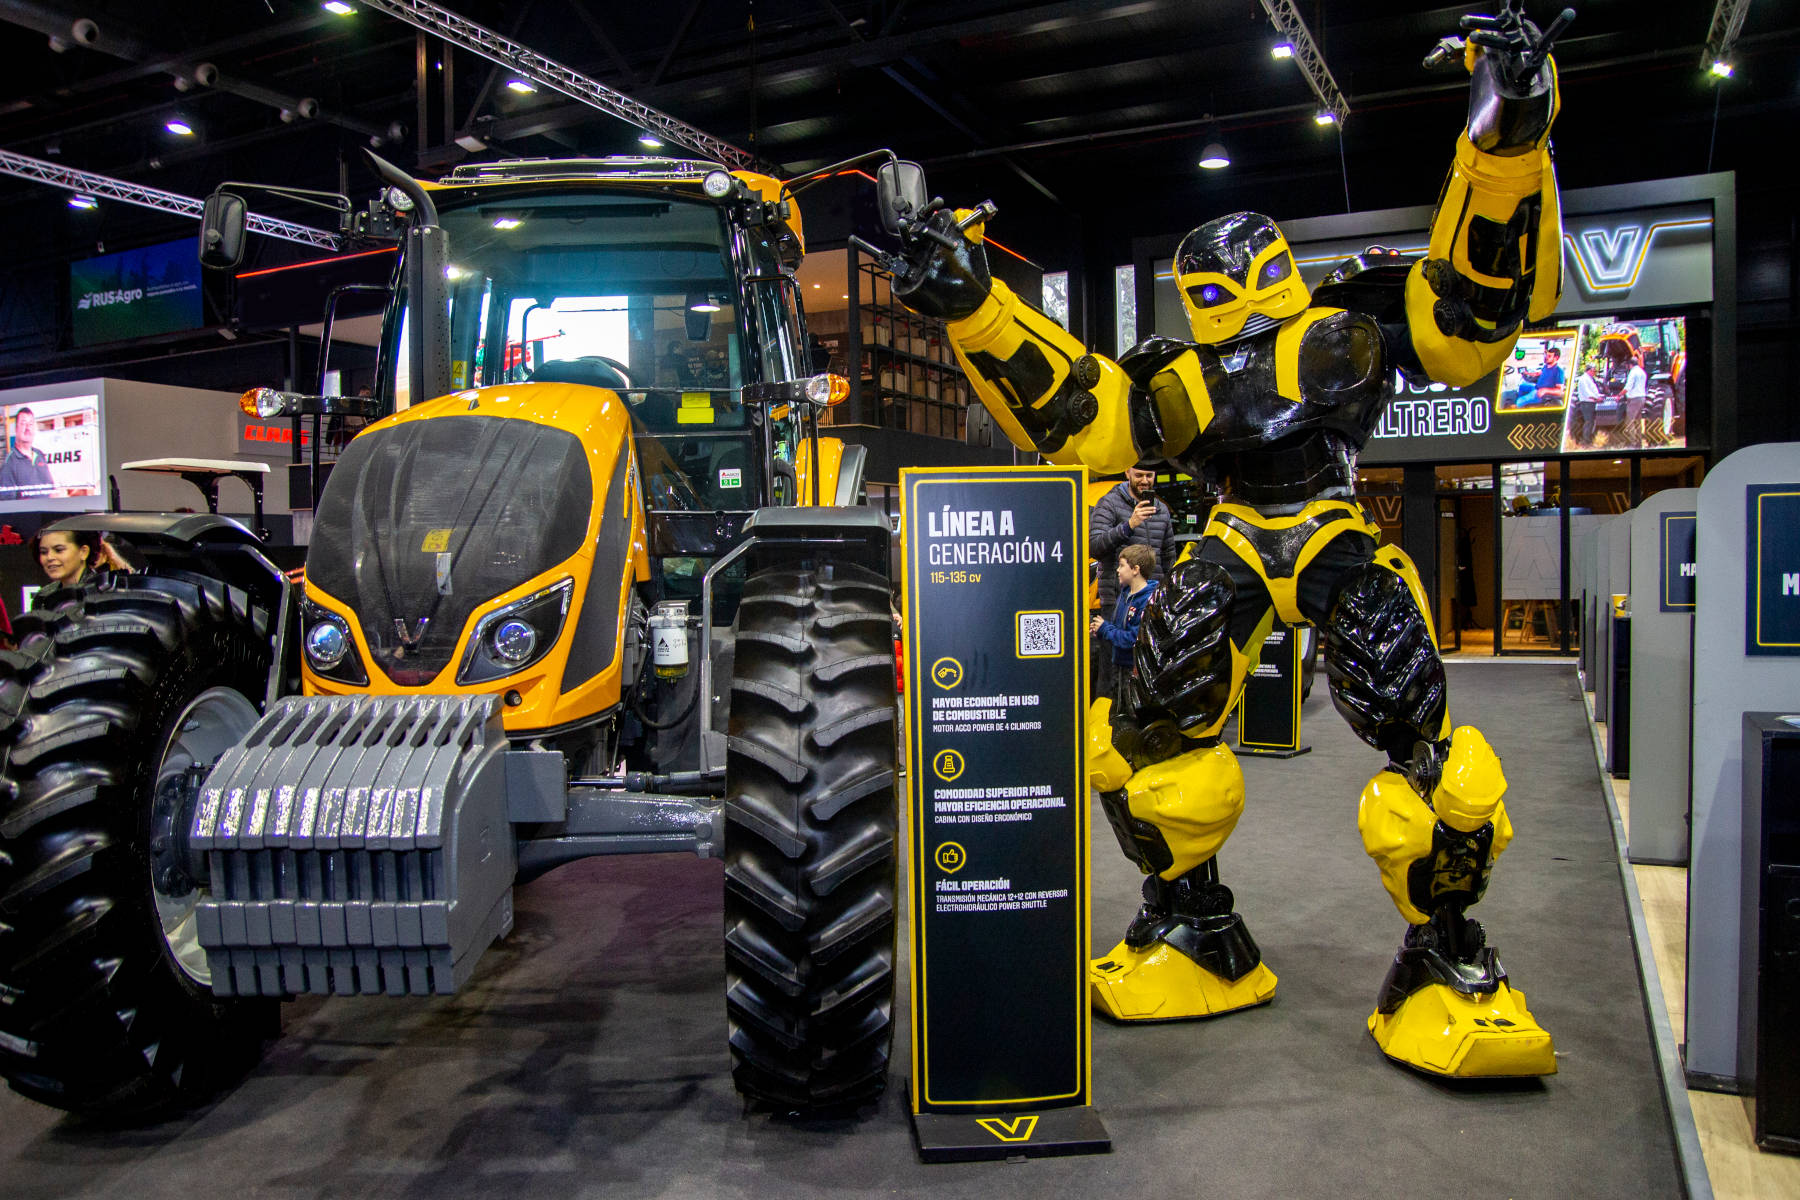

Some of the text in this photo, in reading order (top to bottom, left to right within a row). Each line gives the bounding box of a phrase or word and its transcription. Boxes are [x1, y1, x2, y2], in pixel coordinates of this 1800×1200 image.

[929, 504, 1015, 537] LÍNEA A
[929, 536, 1063, 565] GENERACIÓN 4
[930, 571, 981, 584] 115-135 cv
[933, 693, 1039, 708] MAYOR ECONOMÍA EN USO
[933, 709, 1006, 721] DE COMBUSTIBLE
[933, 724, 953, 732] MOTOR
[972, 723, 995, 731] POWER
[996, 723, 1004, 731] DE
[1004, 723, 1009, 731] 4
[1011, 722, 1041, 730] CILINDROS
[934, 785, 1051, 799] COMODIDAD SUPERIOR PARA
[935, 797, 1066, 812] MAYOR EFICIENCIA OPERACIONAL
[935, 812, 1032, 823] CABINA CON DISEÑO ERGONÓMICO
[936, 877, 1010, 891] FÁCIL OPERACIÓN
[936, 889, 1068, 903] TRANSMISIÓN MECÁNICA 12+12 CON REVERSOR
[936, 900, 1047, 912] ELECTROHIDRÁULICO POWER SHUTTLE
